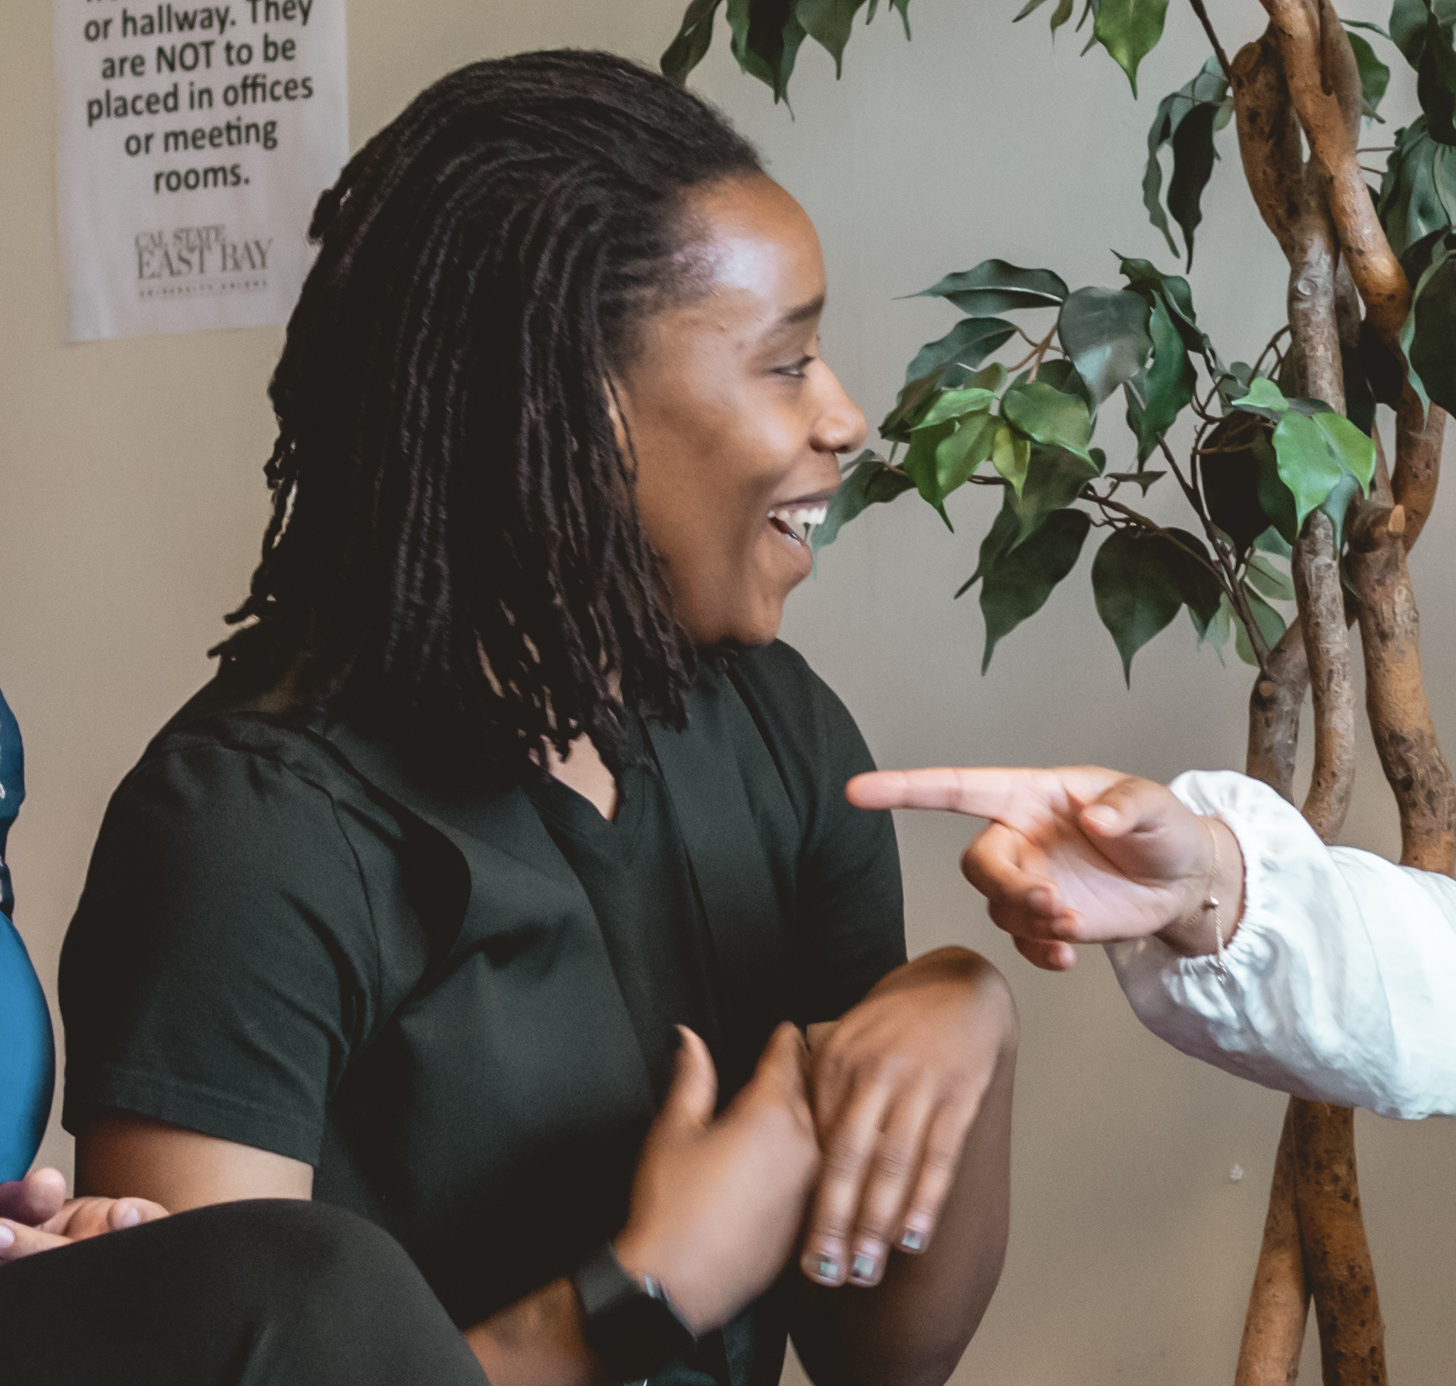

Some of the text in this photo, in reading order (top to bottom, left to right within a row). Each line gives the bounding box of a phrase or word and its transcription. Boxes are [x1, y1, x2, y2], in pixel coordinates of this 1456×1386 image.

[84, 16, 113, 43] or
[121, 3, 236, 40] hallway.
[101, 32, 296, 80] are NOT to be
[86, 74, 314, 128] placed in offices
[124, 116, 278, 157] or meeting
[153, 162, 250, 195] rooms.
[138, 237, 273, 280] EAST BAY
